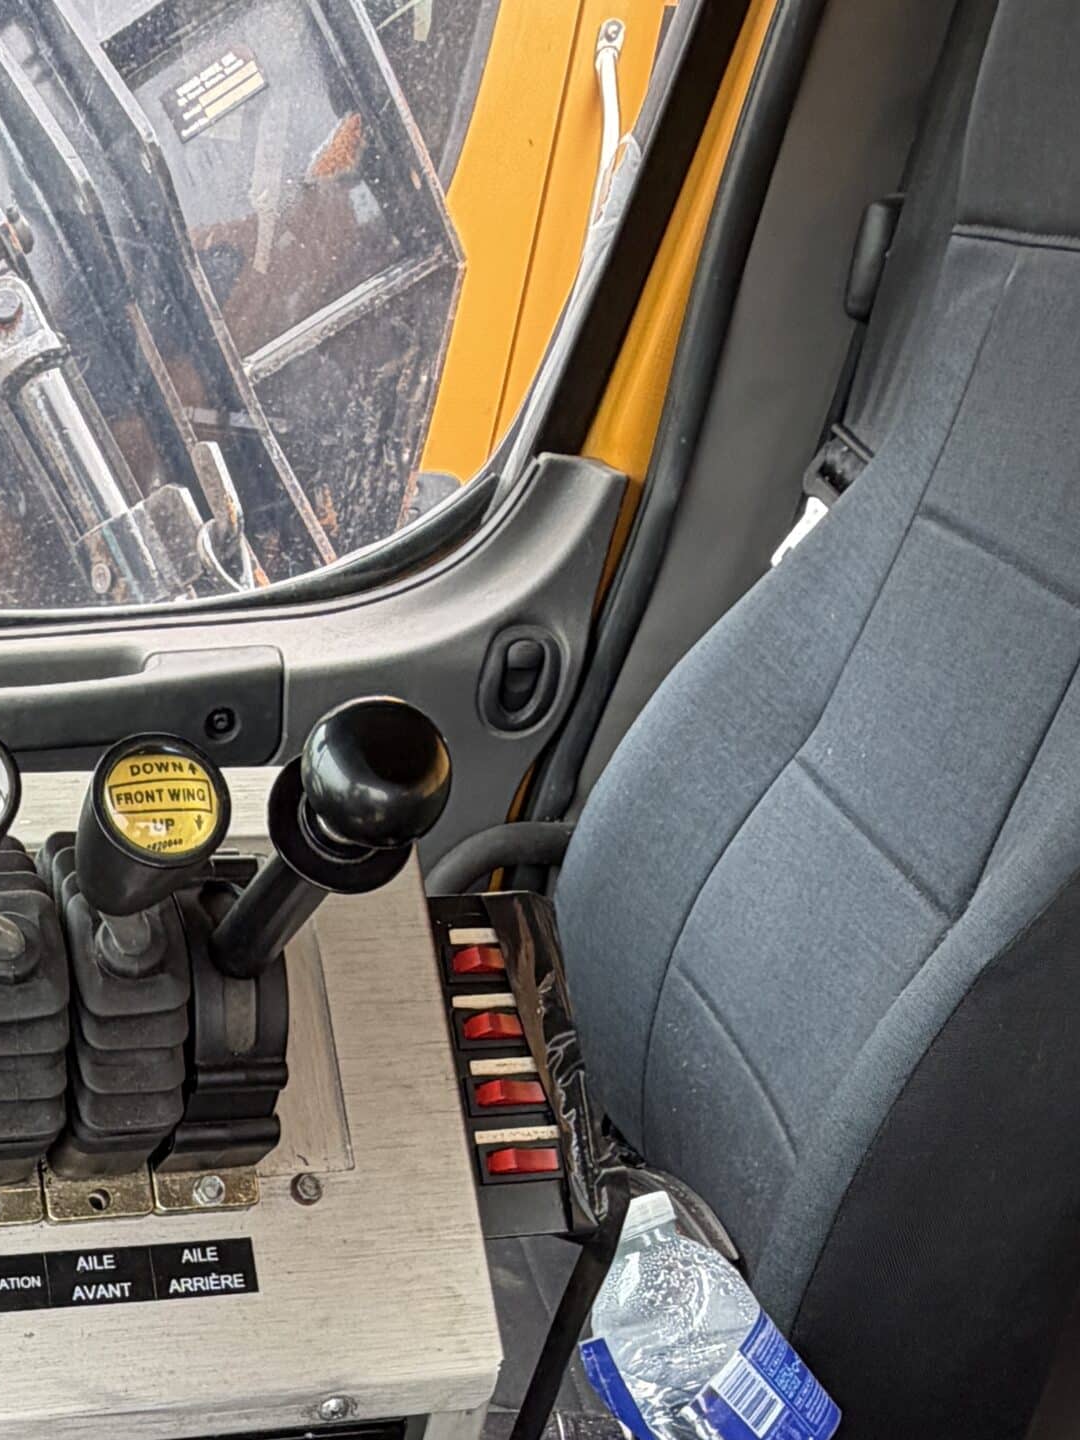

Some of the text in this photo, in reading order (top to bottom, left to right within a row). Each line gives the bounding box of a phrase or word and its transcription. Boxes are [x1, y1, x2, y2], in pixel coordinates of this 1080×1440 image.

[129, 761, 185, 777] DOWN
[116, 787, 207, 806] FRONT WING
[152, 817, 176, 833] UP
[76, 1253, 116, 1272] AILE
[181, 1246, 219, 1264] AILE
[72, 1282, 132, 1301] AVANT
[169, 1271, 246, 1294] ARRIÈRE
